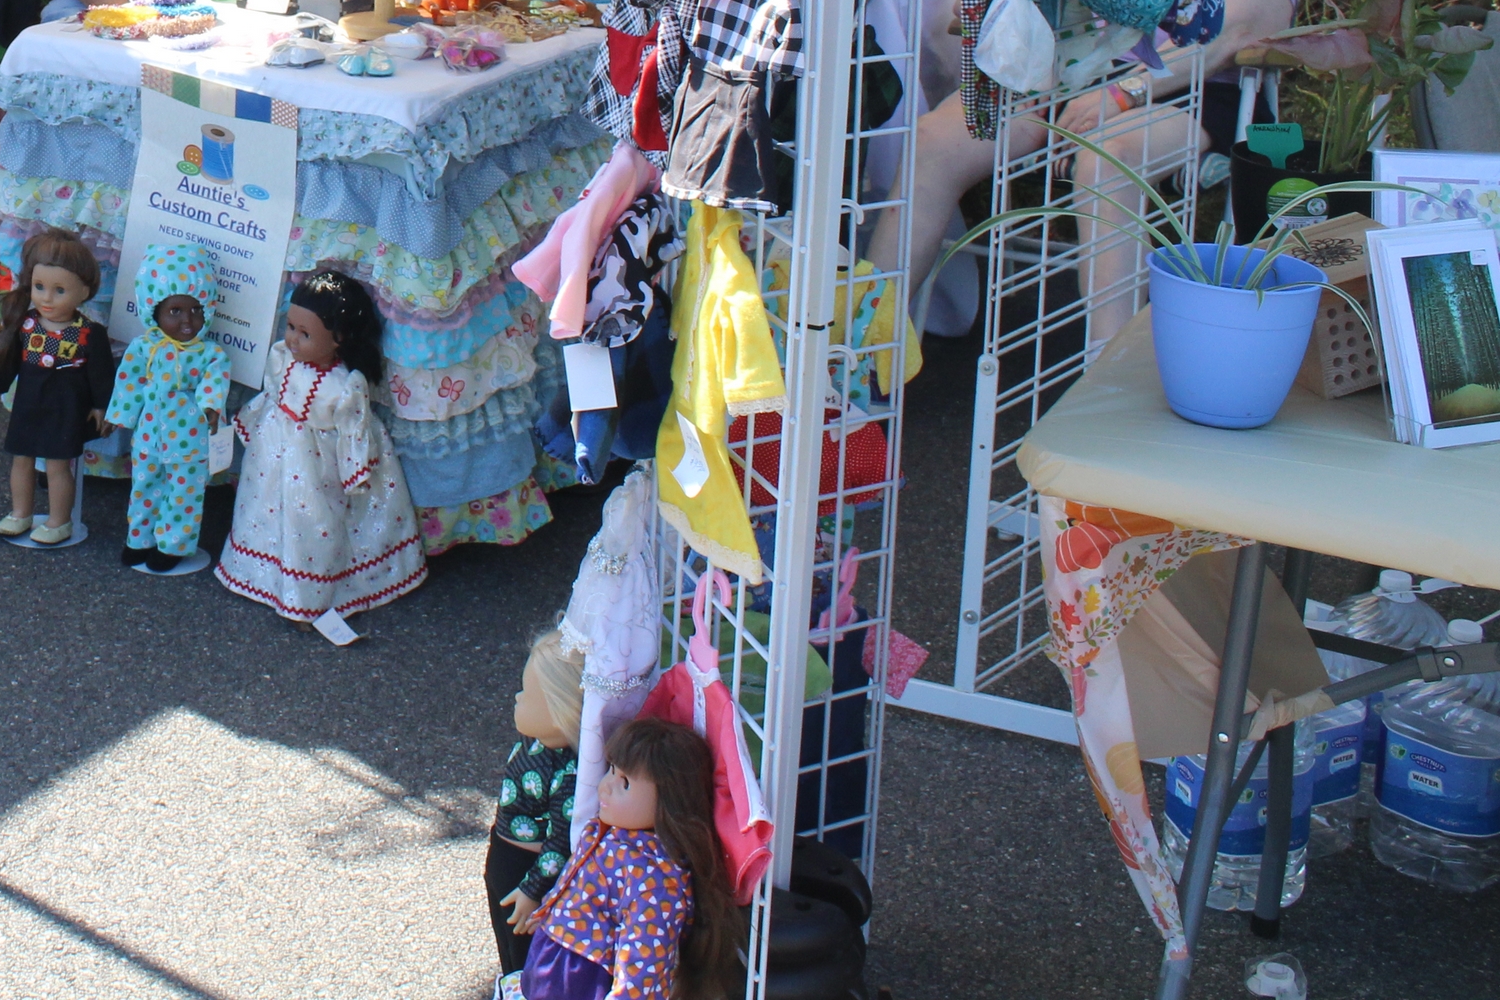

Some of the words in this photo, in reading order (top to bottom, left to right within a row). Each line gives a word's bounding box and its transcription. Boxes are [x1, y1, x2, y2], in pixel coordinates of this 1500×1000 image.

[177, 175, 247, 209] Auntie's
[149, 191, 212, 224] Custom
[217, 211, 267, 241] Crafts
[159, 224, 184, 239] NEED
[185, 231, 222, 251] SEWING
[223, 243, 255, 261] DONE?
[216, 278, 242, 293] MORE
[219, 266, 258, 288] BUTTON,
[222, 332, 257, 354] ONLY
[1411, 773, 1440, 789] WATER
